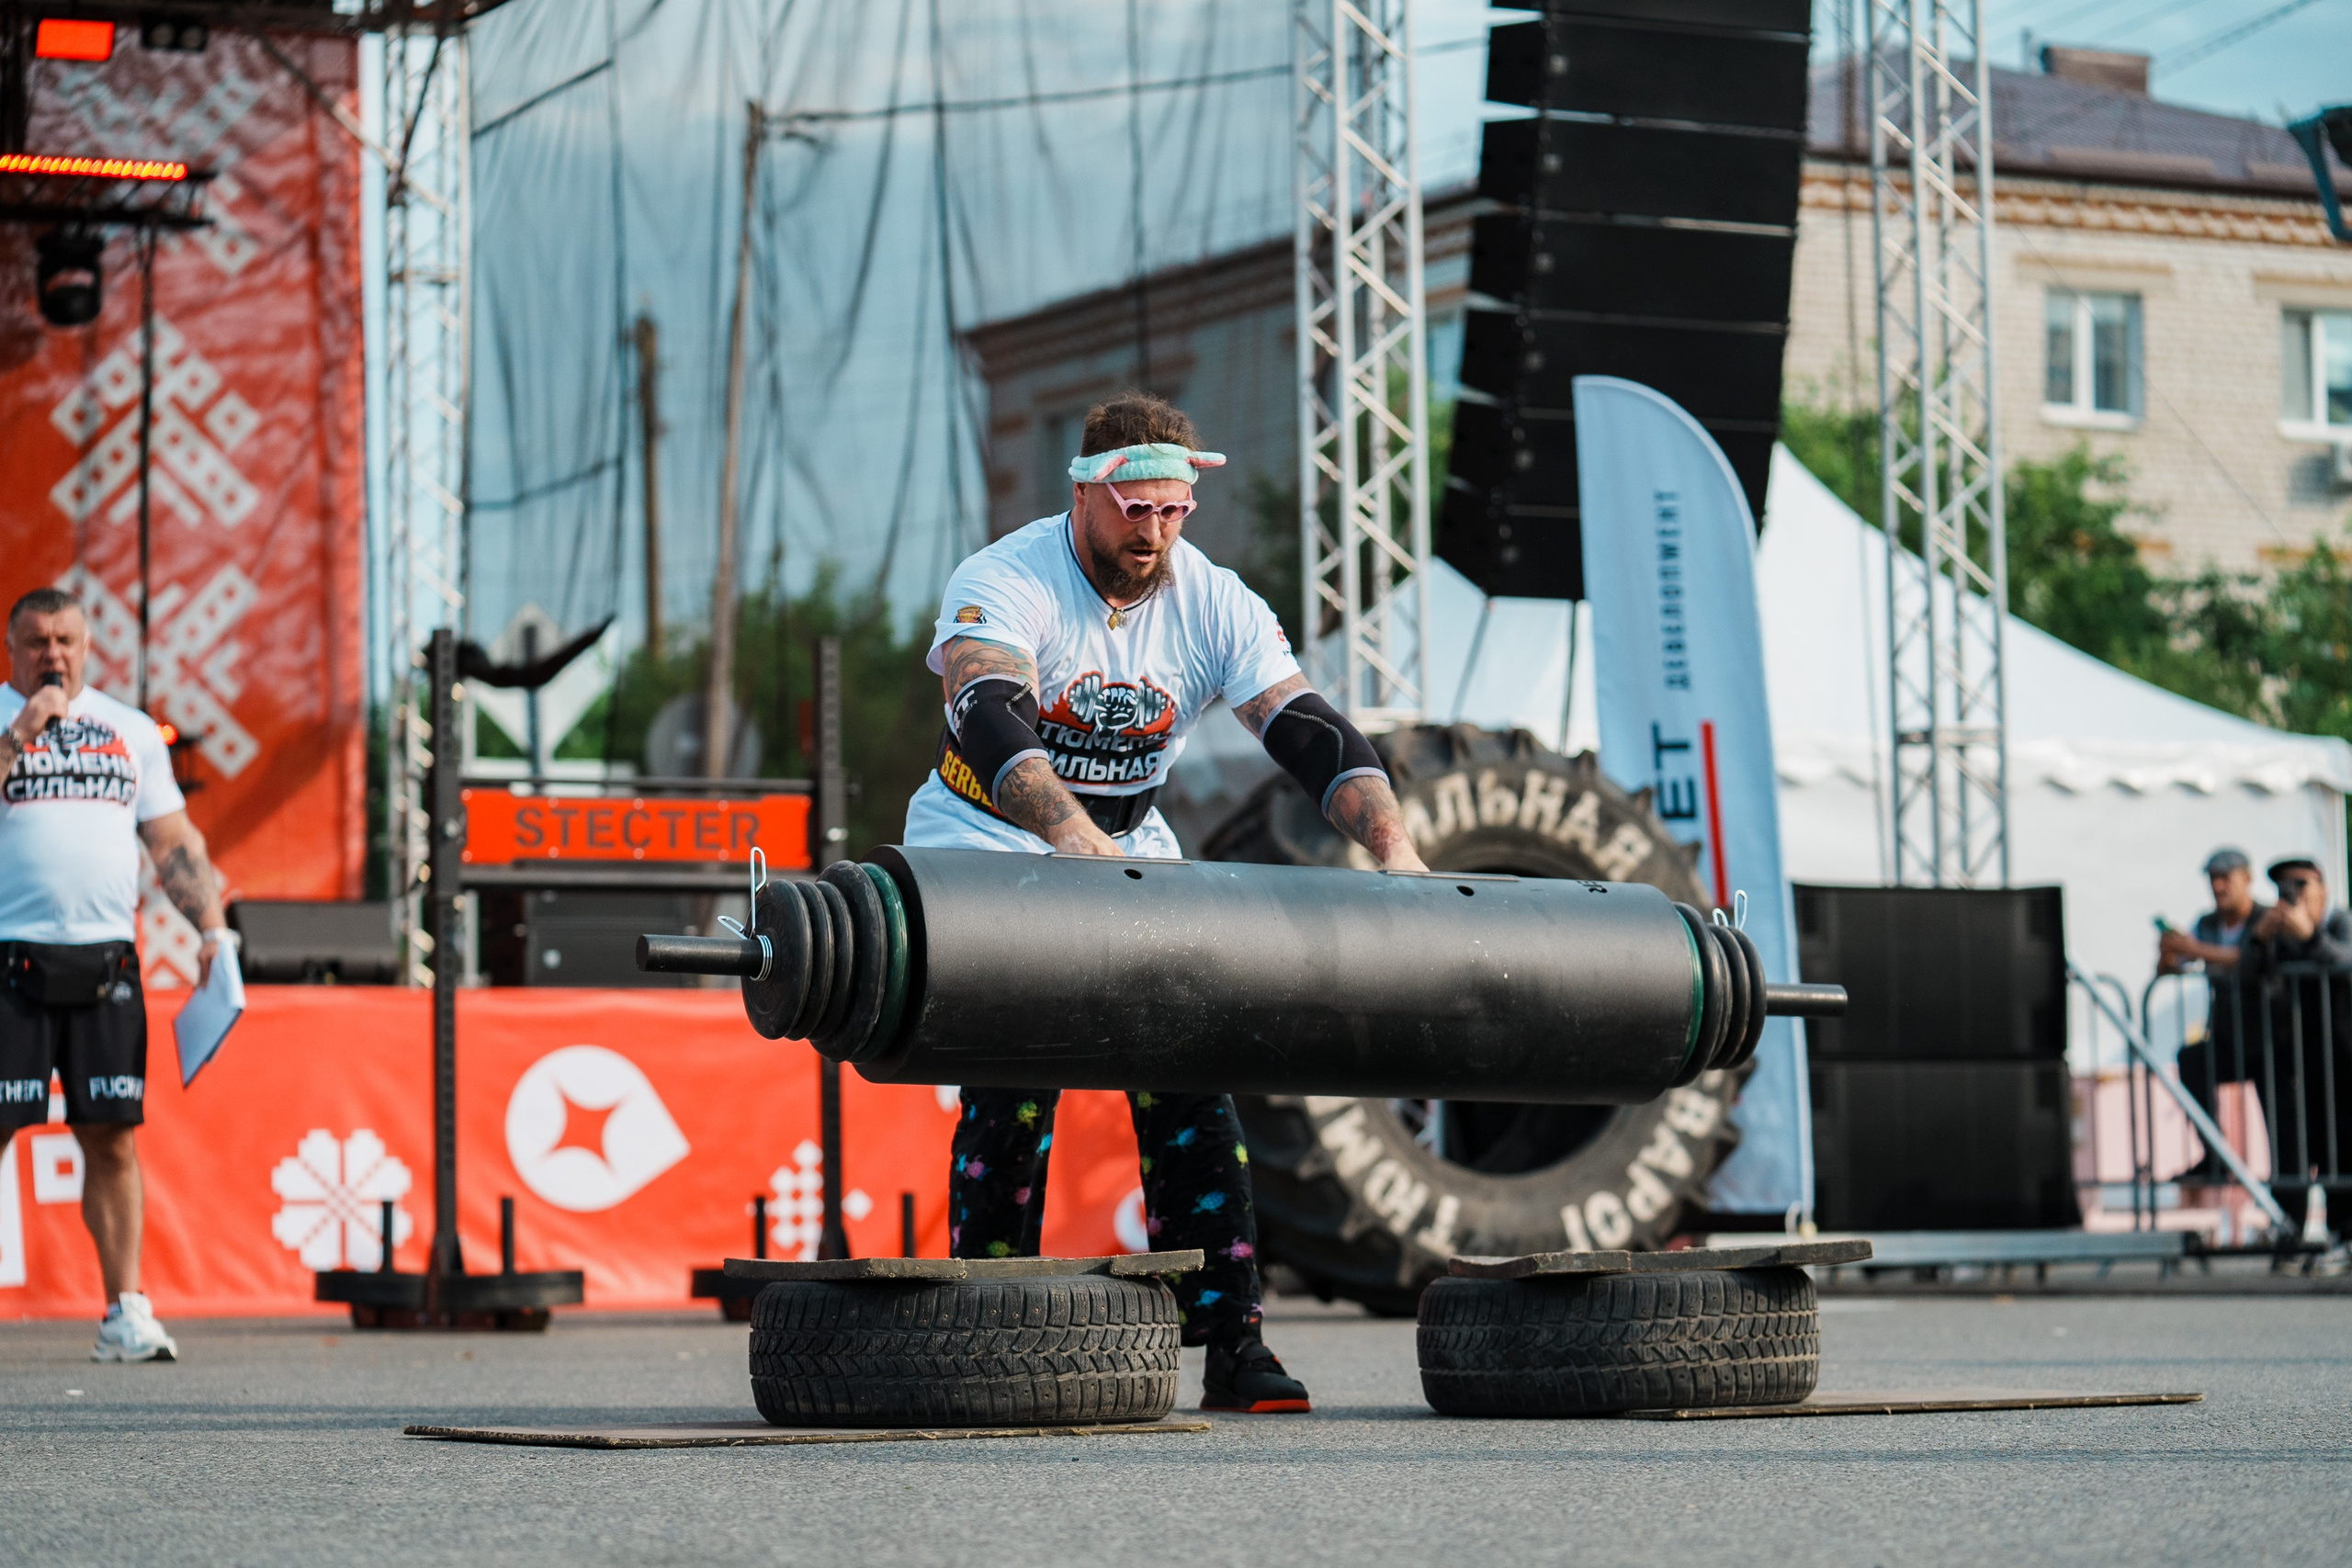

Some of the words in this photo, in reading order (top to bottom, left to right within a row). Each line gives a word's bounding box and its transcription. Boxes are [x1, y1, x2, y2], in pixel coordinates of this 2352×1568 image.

[1047, 749, 1163, 782] ИЛЬНАЯ
[514, 807, 761, 851] STECTER
[1347, 768, 1654, 882] ИЛЬНАЯ
[1304, 1095, 1461, 1258] ТЮМ
[1559, 1068, 1725, 1254] ВАРОГ
